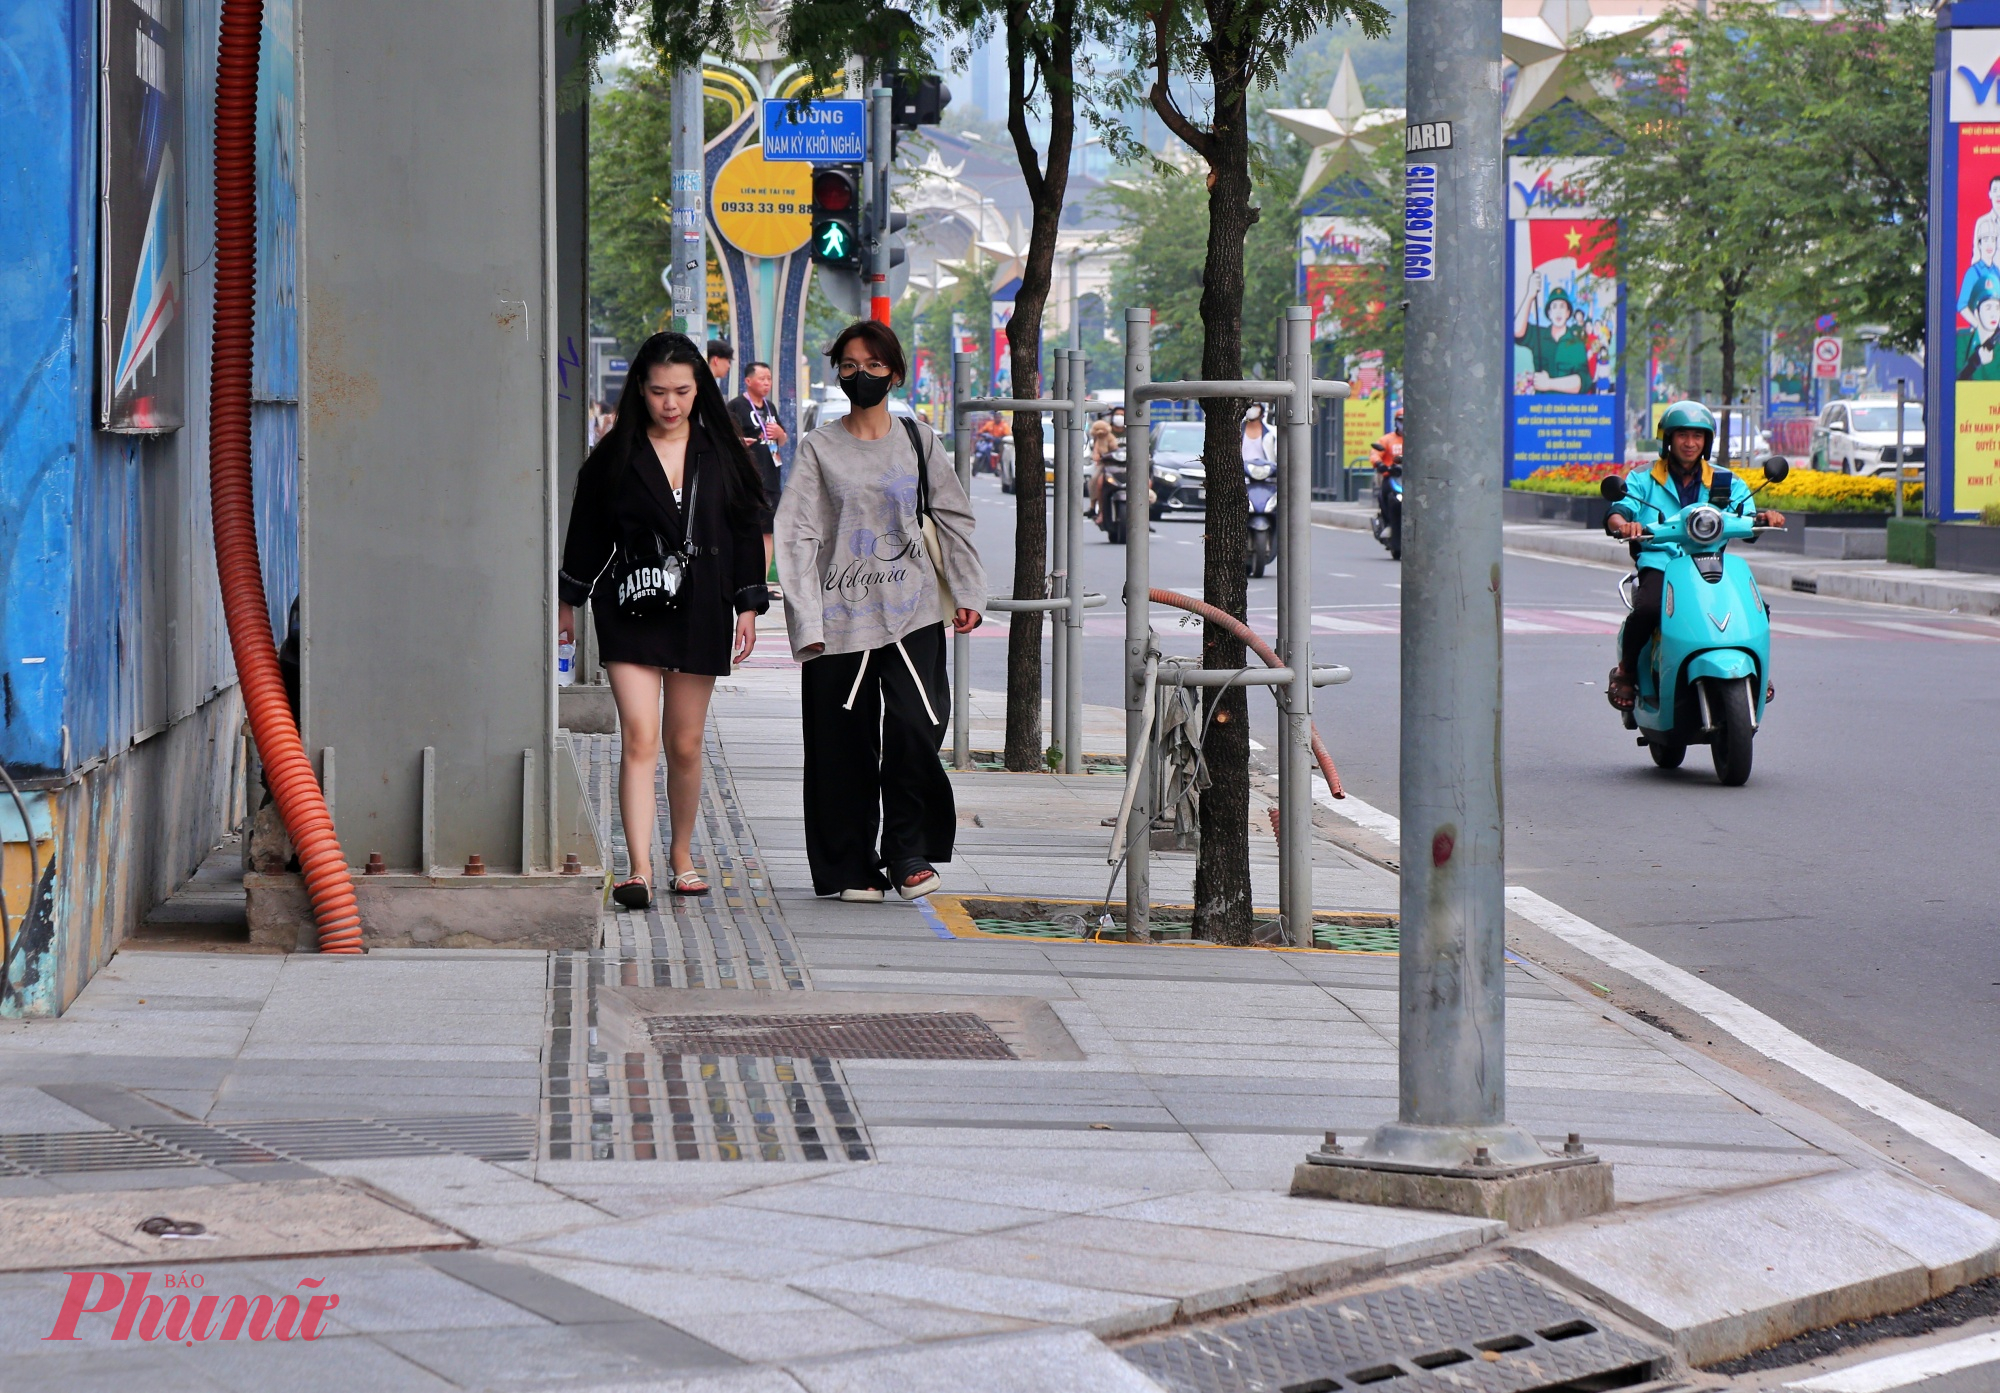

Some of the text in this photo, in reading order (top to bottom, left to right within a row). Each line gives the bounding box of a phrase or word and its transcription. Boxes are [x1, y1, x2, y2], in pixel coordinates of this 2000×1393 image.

[767, 129, 862, 154] NAM KỲ KHỞI NGHĨA
[618, 567, 676, 606] SAIGON
[825, 559, 909, 602] Urbania
